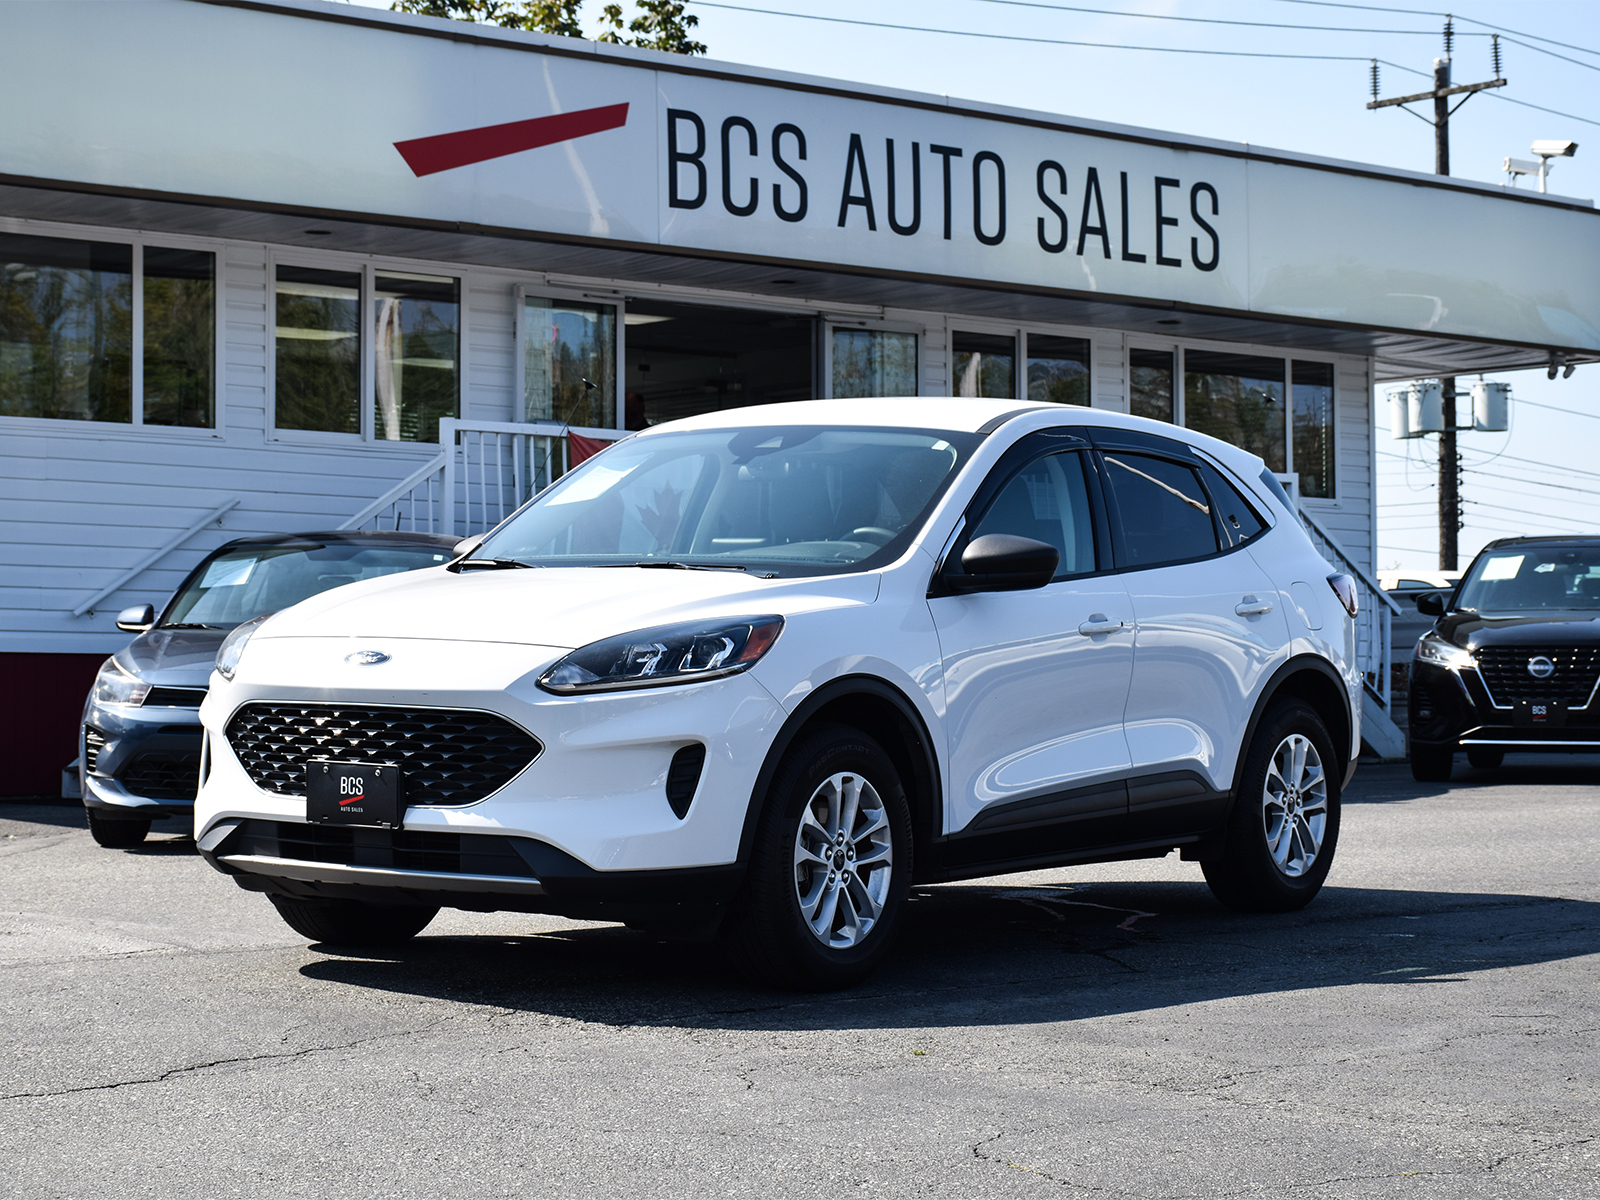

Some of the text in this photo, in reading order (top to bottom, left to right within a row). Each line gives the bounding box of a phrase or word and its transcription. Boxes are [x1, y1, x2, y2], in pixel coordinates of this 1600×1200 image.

[667, 108, 1219, 272] BCS AUTO SALES
[1532, 705, 1547, 715] BCS
[340, 776, 364, 795] BCS
